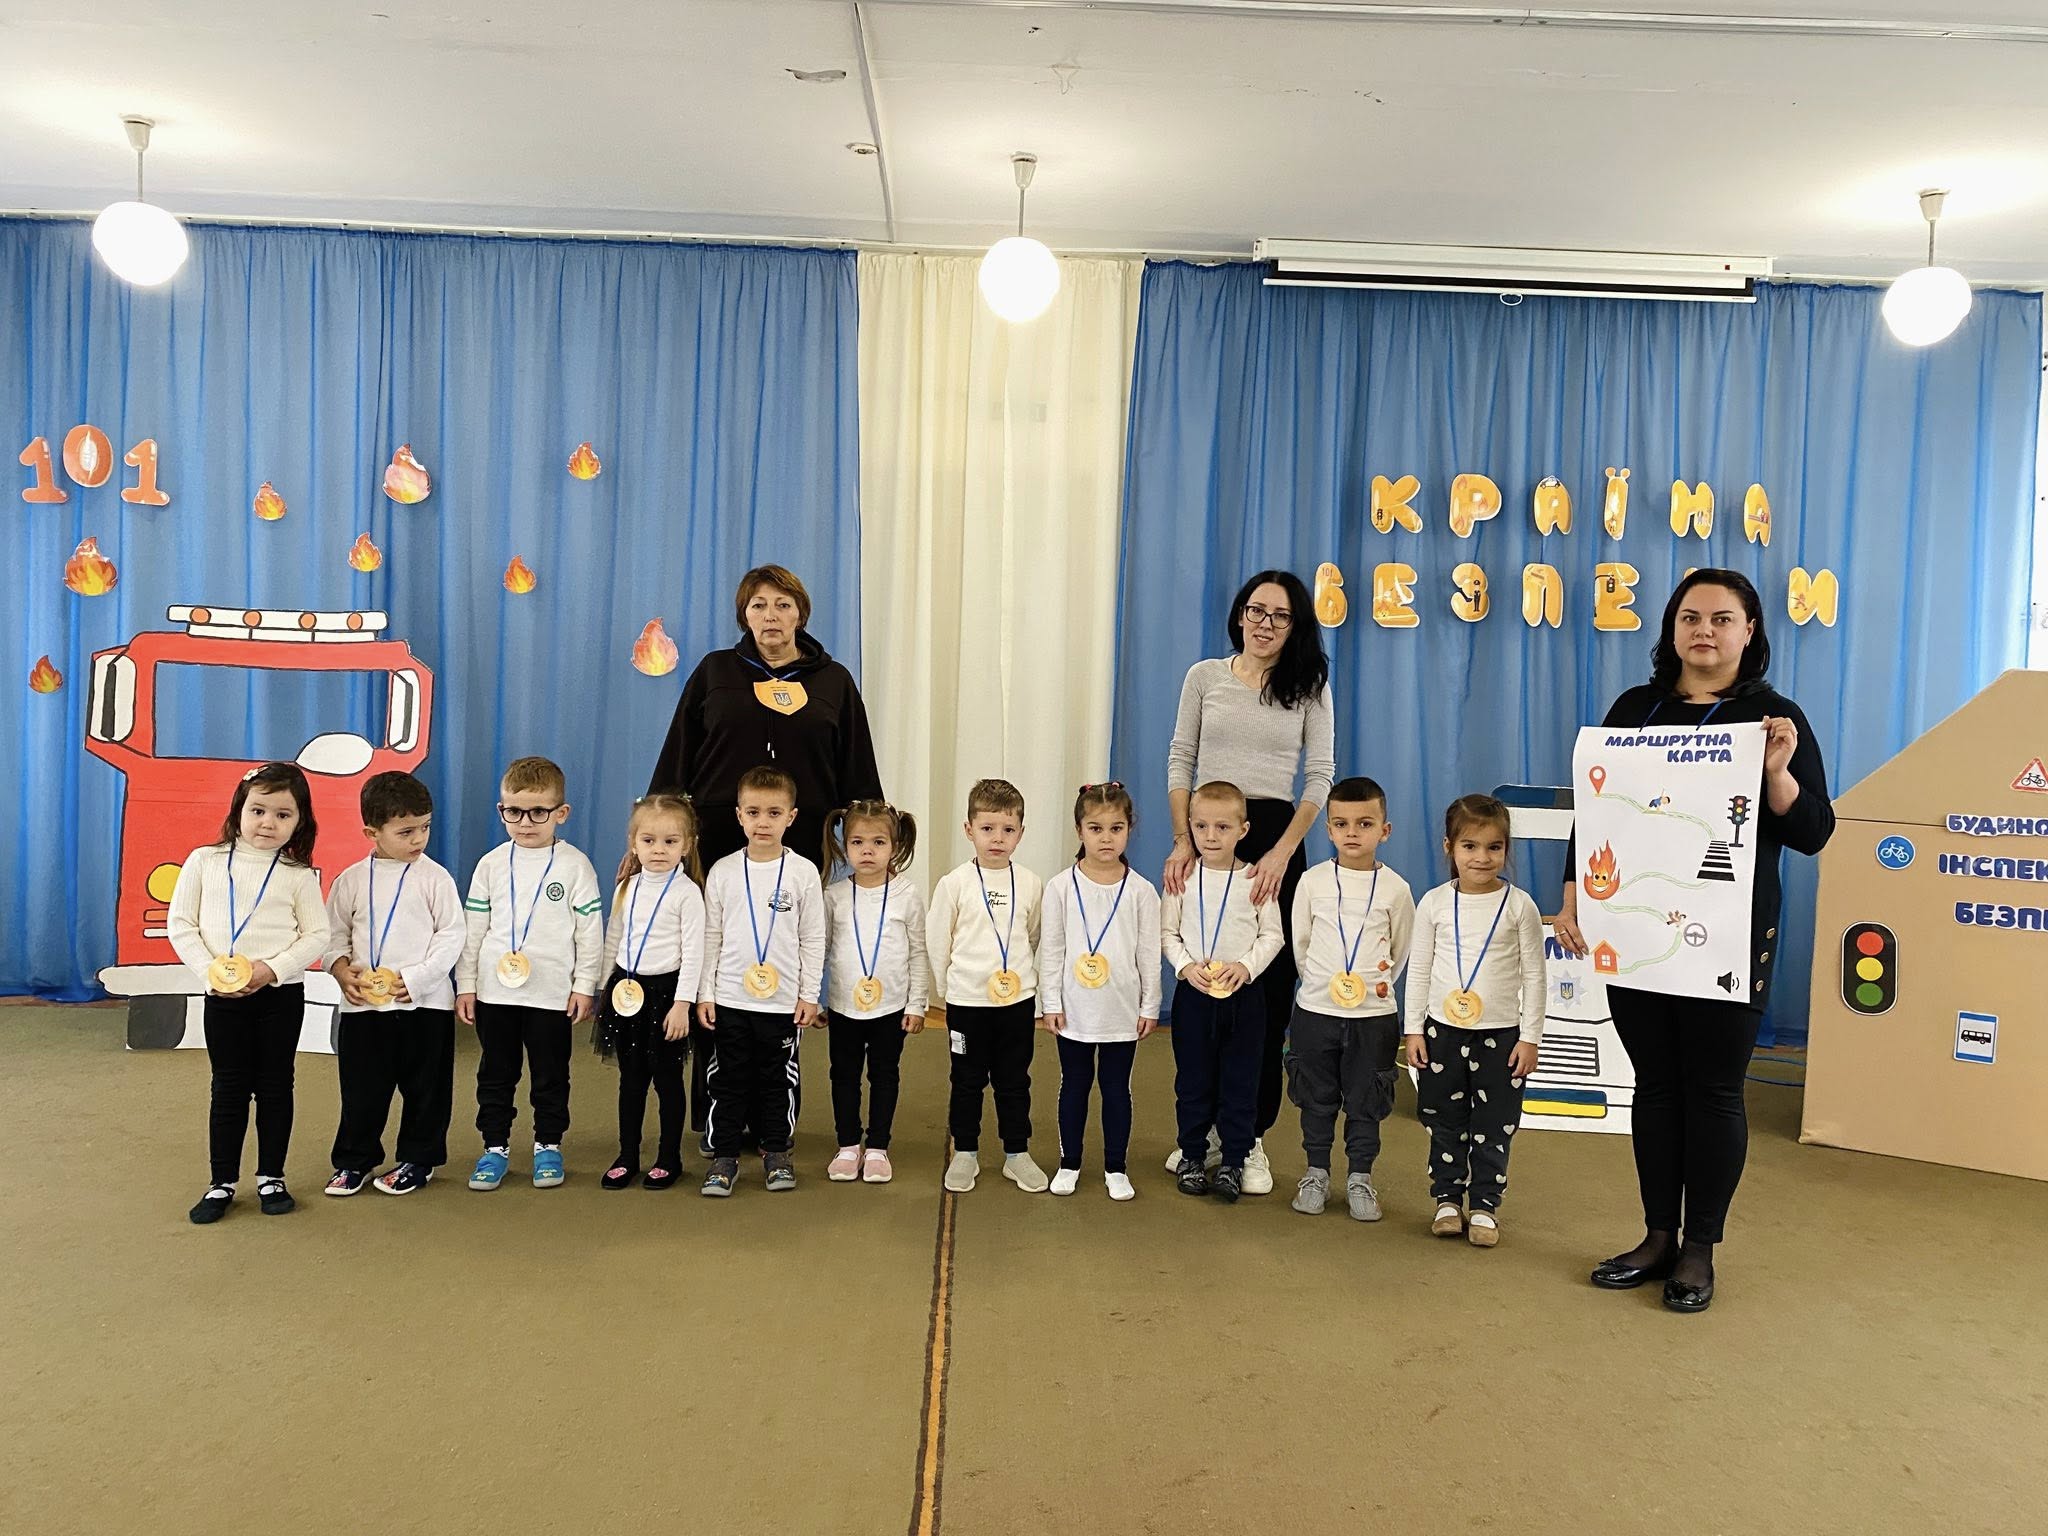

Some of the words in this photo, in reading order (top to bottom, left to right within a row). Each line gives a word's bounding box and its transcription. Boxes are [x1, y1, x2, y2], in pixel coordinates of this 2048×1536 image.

[19, 424, 170, 506] 101
[1371, 466, 1772, 548] КРАЇНА
[1314, 562, 1839, 632] БЕЗПЕИ
[1604, 732, 1733, 747] МАРШРУТНА
[1667, 748, 1733, 763] КАРТА
[1947, 814, 2048, 836] БУДИНО
[1954, 901, 2048, 931] БЕЗП
